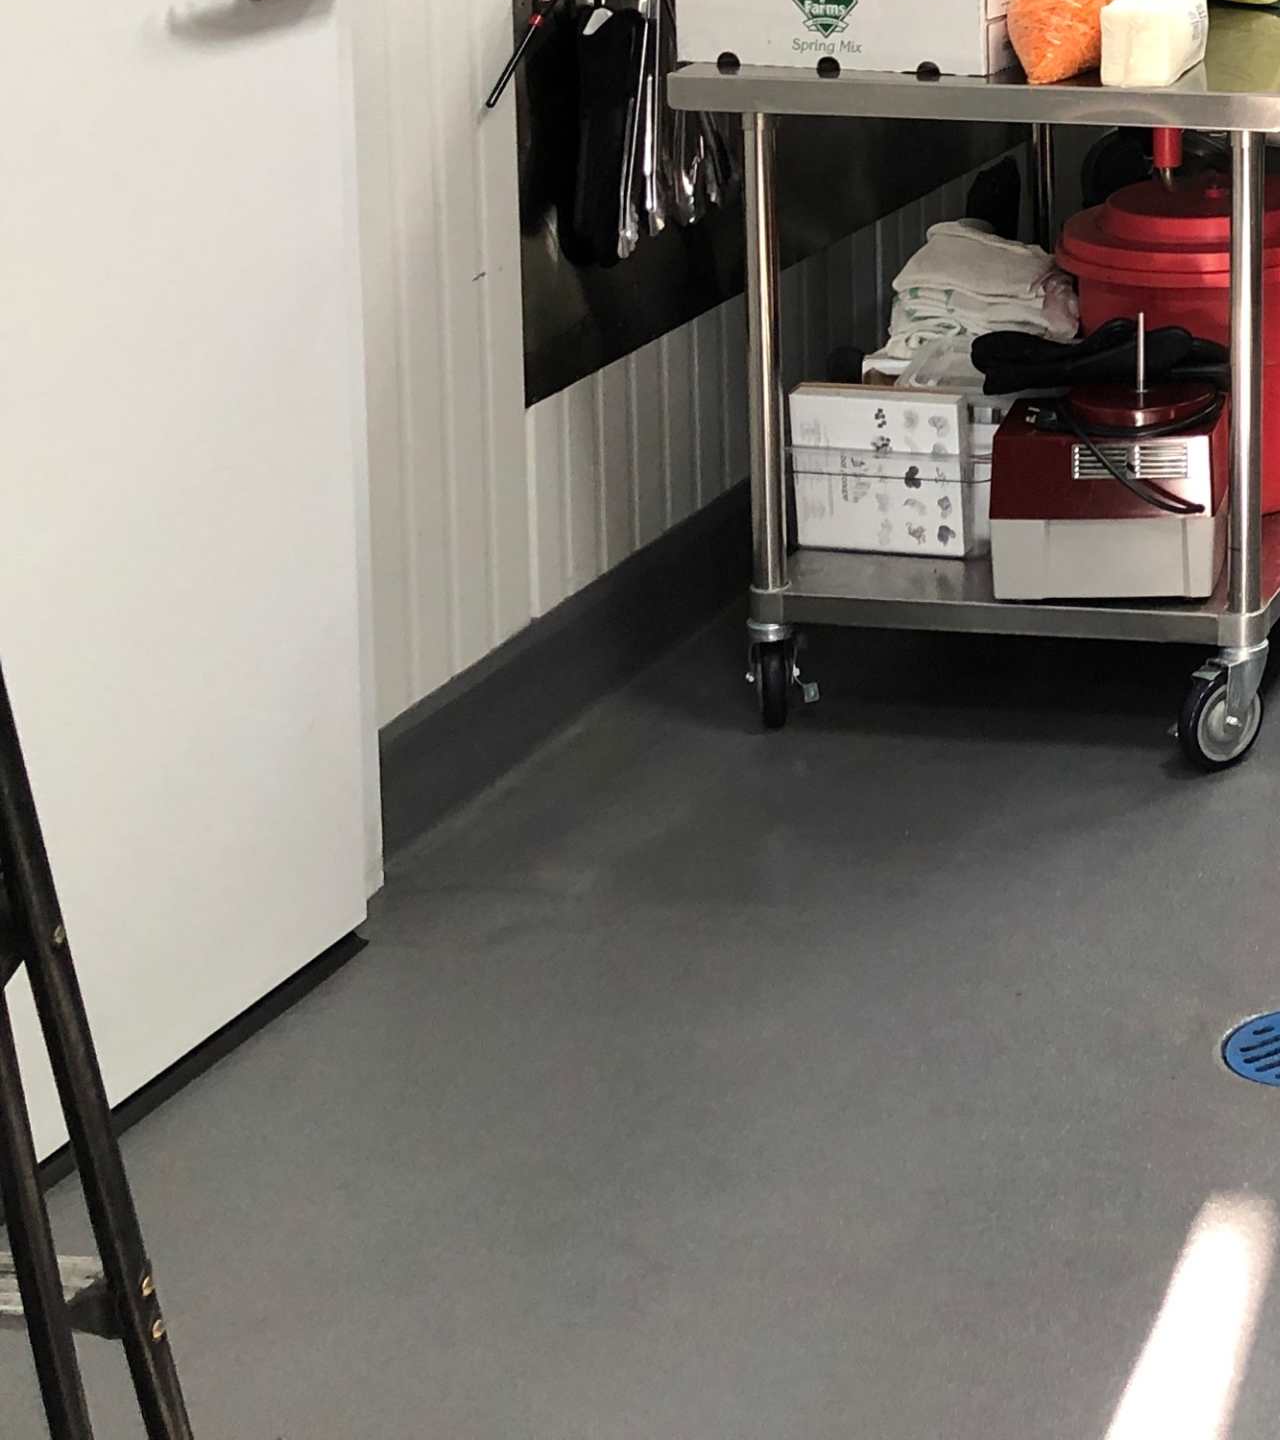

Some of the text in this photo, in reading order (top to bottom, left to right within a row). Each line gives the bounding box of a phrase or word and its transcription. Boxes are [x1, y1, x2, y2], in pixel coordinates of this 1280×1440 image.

[804, 1, 846, 16] Farms
[792, 38, 862, 54] Spring Mix
